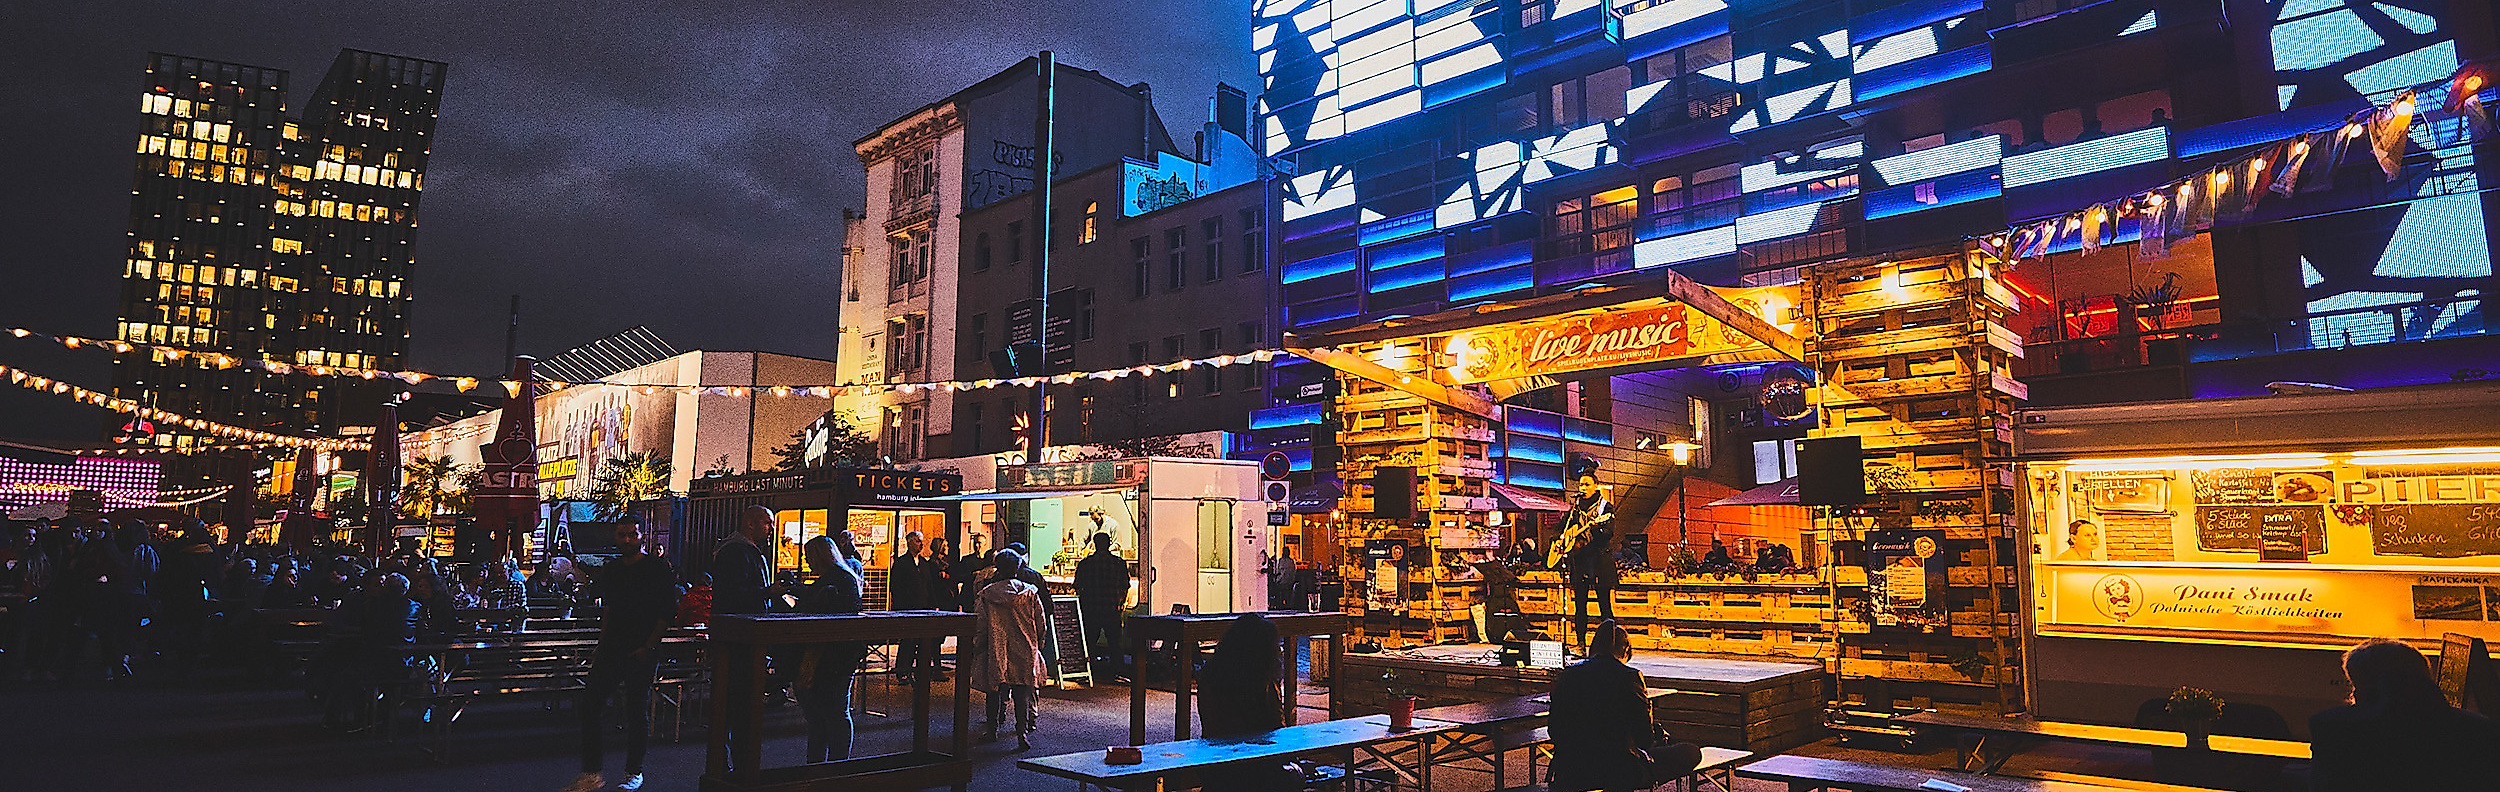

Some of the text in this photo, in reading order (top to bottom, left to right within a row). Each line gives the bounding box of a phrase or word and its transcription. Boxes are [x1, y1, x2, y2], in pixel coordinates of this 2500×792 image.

[1530, 314, 1682, 361] live music
[713, 476, 804, 493] HAMBURG LAST MINUTE
[855, 474, 949, 492] TICKETS
[2077, 479, 2141, 492] BESTELLEN
[876, 493, 909, 502] hamburg
[2208, 510, 2218, 521] 5
[2264, 514, 2293, 522] EXTRA
[2206, 520, 2214, 530] 6
[2173, 584, 2313, 602] Pani Smak
[2149, 602, 2343, 619] Polnische Köstlichkeiten
